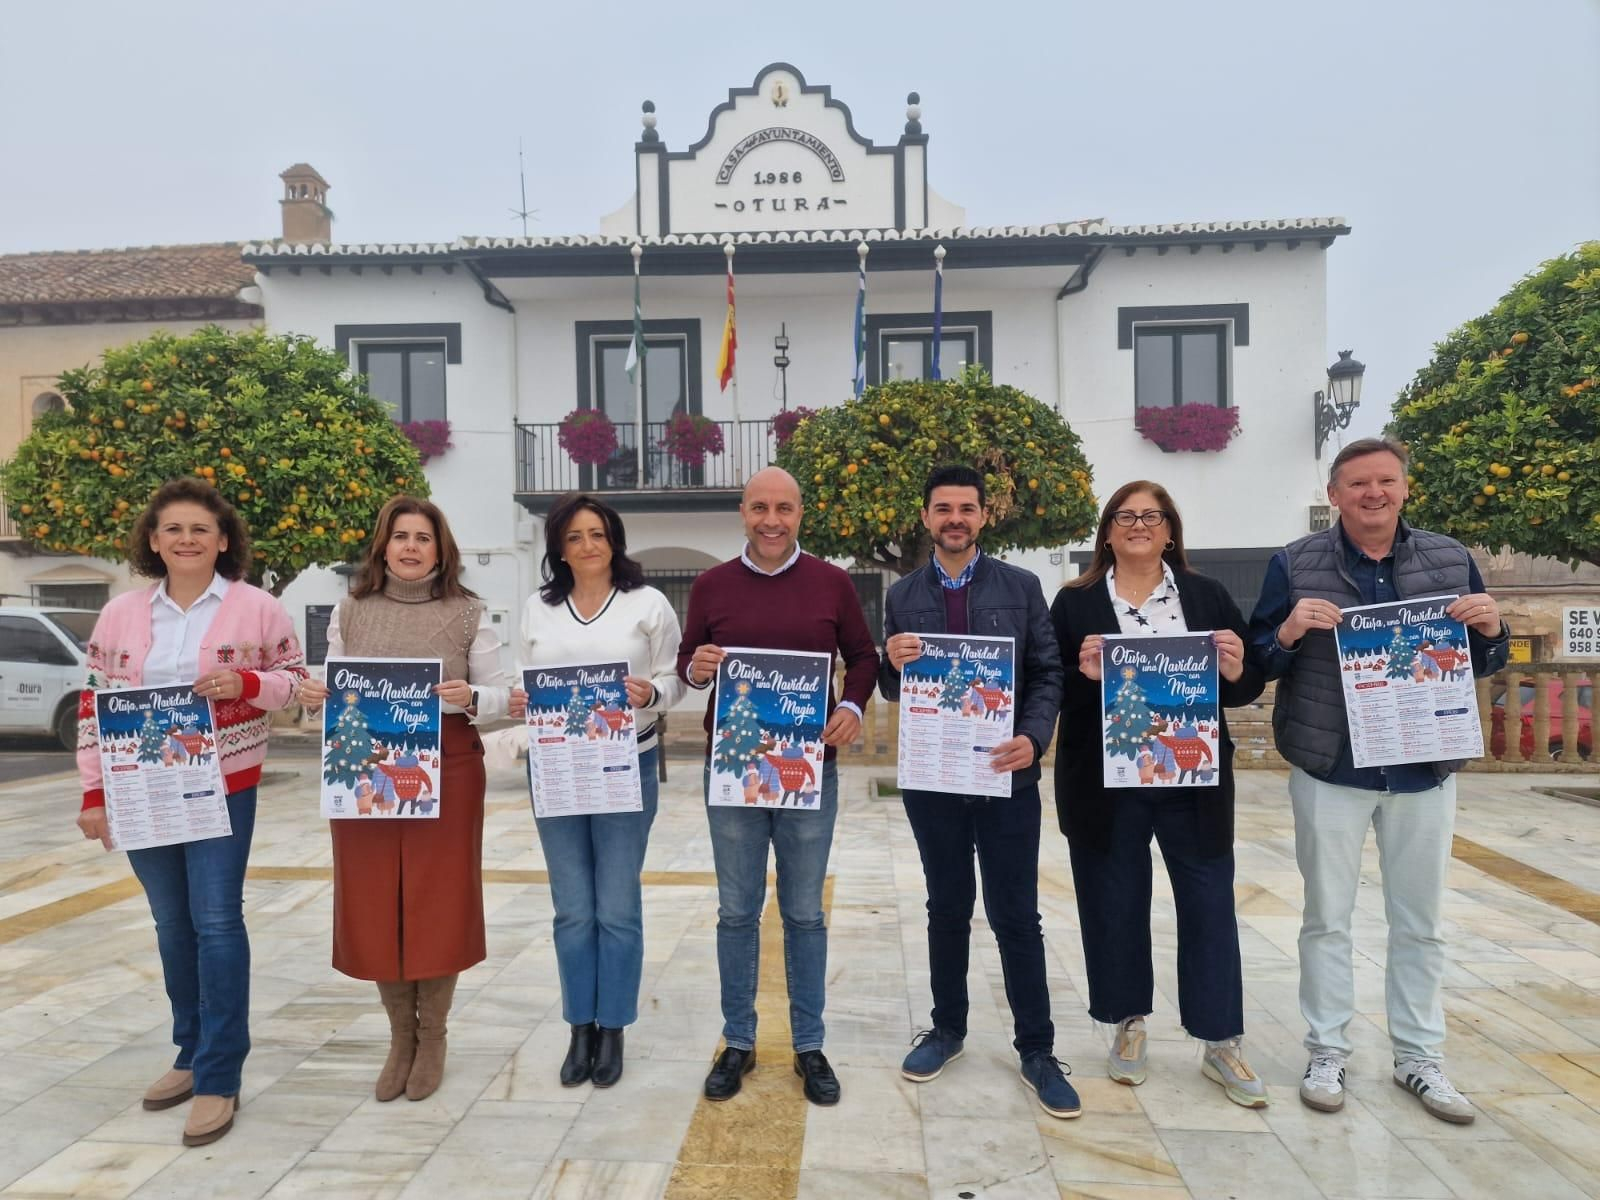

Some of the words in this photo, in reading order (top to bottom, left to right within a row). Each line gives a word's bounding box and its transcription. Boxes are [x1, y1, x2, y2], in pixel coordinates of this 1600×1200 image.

[720, 149, 744, 180] CASA
[759, 130, 841, 178] AYUNTAMIENTO
[754, 172, 802, 184] 1.986
[1399, 606, 1446, 626] Navidad
[1570, 610, 1588, 625] SE
[1419, 625, 1452, 644] Magia
[1570, 628, 1593, 638] 640
[960, 643, 999, 663] Navidad
[1570, 642, 1592, 652] 958
[974, 663, 1002, 683] Magia
[1155, 653, 1208, 677] Navidad
[577, 669, 616, 688] Navidad
[769, 670, 819, 696] Navidad
[149, 691, 193, 711] Navidad
[378, 678, 431, 704] Navidad
[593, 687, 620, 704] Magia
[1168, 677, 1207, 706] Magia
[168, 709, 199, 729] Magia
[390, 704, 429, 734] Magia
[780, 696, 816, 725] Magia
